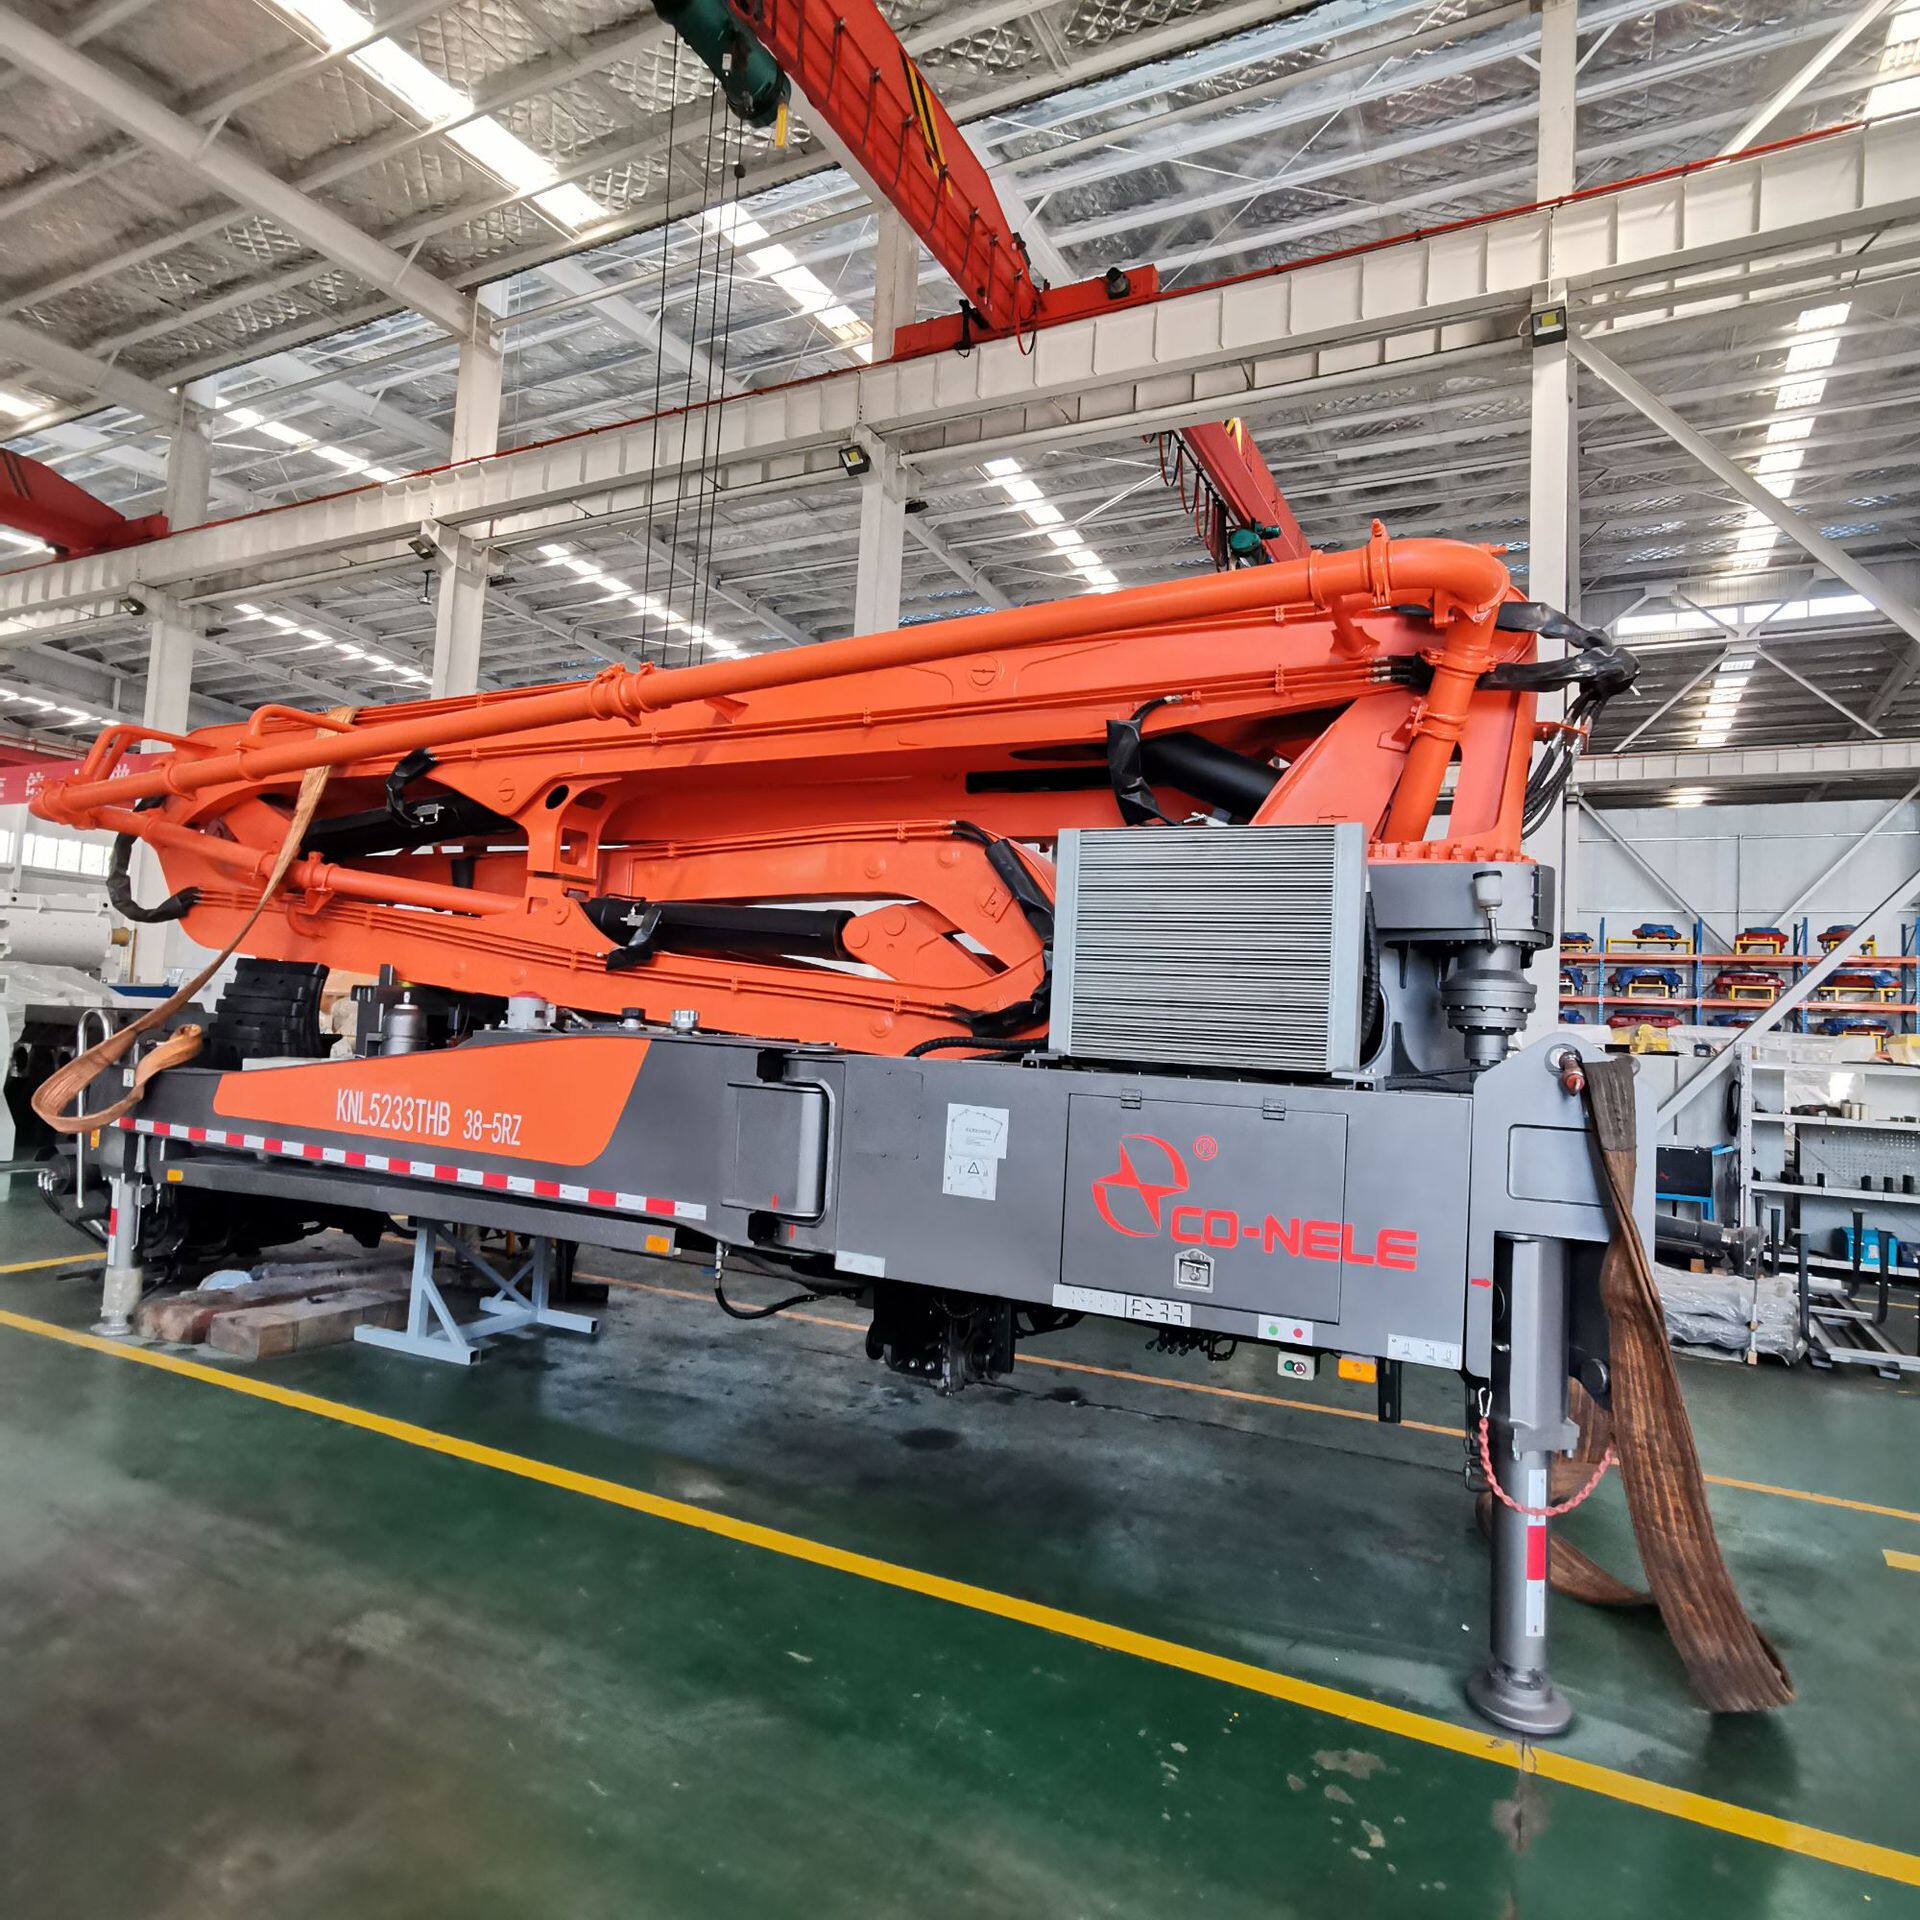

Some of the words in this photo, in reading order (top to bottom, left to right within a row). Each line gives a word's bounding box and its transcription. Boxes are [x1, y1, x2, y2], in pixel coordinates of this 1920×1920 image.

[335, 1088, 451, 1137] KNL5233THB
[463, 1108, 522, 1146] 38-5RZ
[1170, 1204, 1418, 1272] CO-NELE
